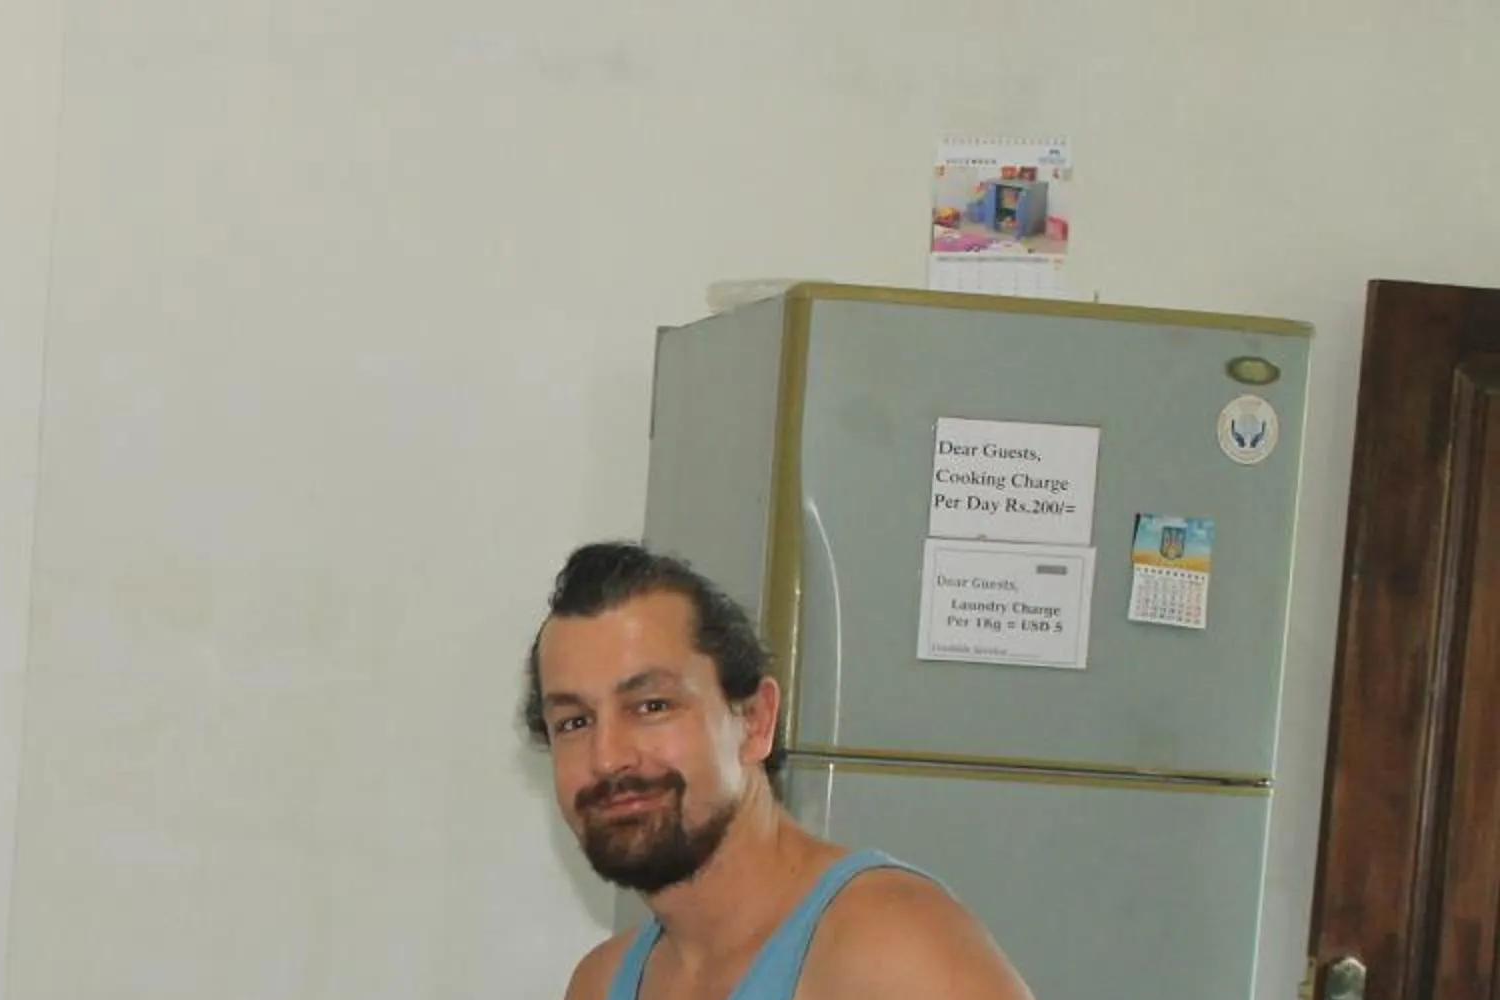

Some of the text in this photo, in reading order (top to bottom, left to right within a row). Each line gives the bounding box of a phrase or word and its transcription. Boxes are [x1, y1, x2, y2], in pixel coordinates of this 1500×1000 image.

[939, 440, 1042, 462] Dear Guests,
[935, 469, 1069, 494] Cooking Charge
[934, 493, 1077, 516] Per Day Rs.200/=
[937, 575, 969, 588] Dear
[951, 599, 1062, 619] Laundry Charge
[947, 615, 969, 627] Per
[1021, 619, 1050, 632] USD
